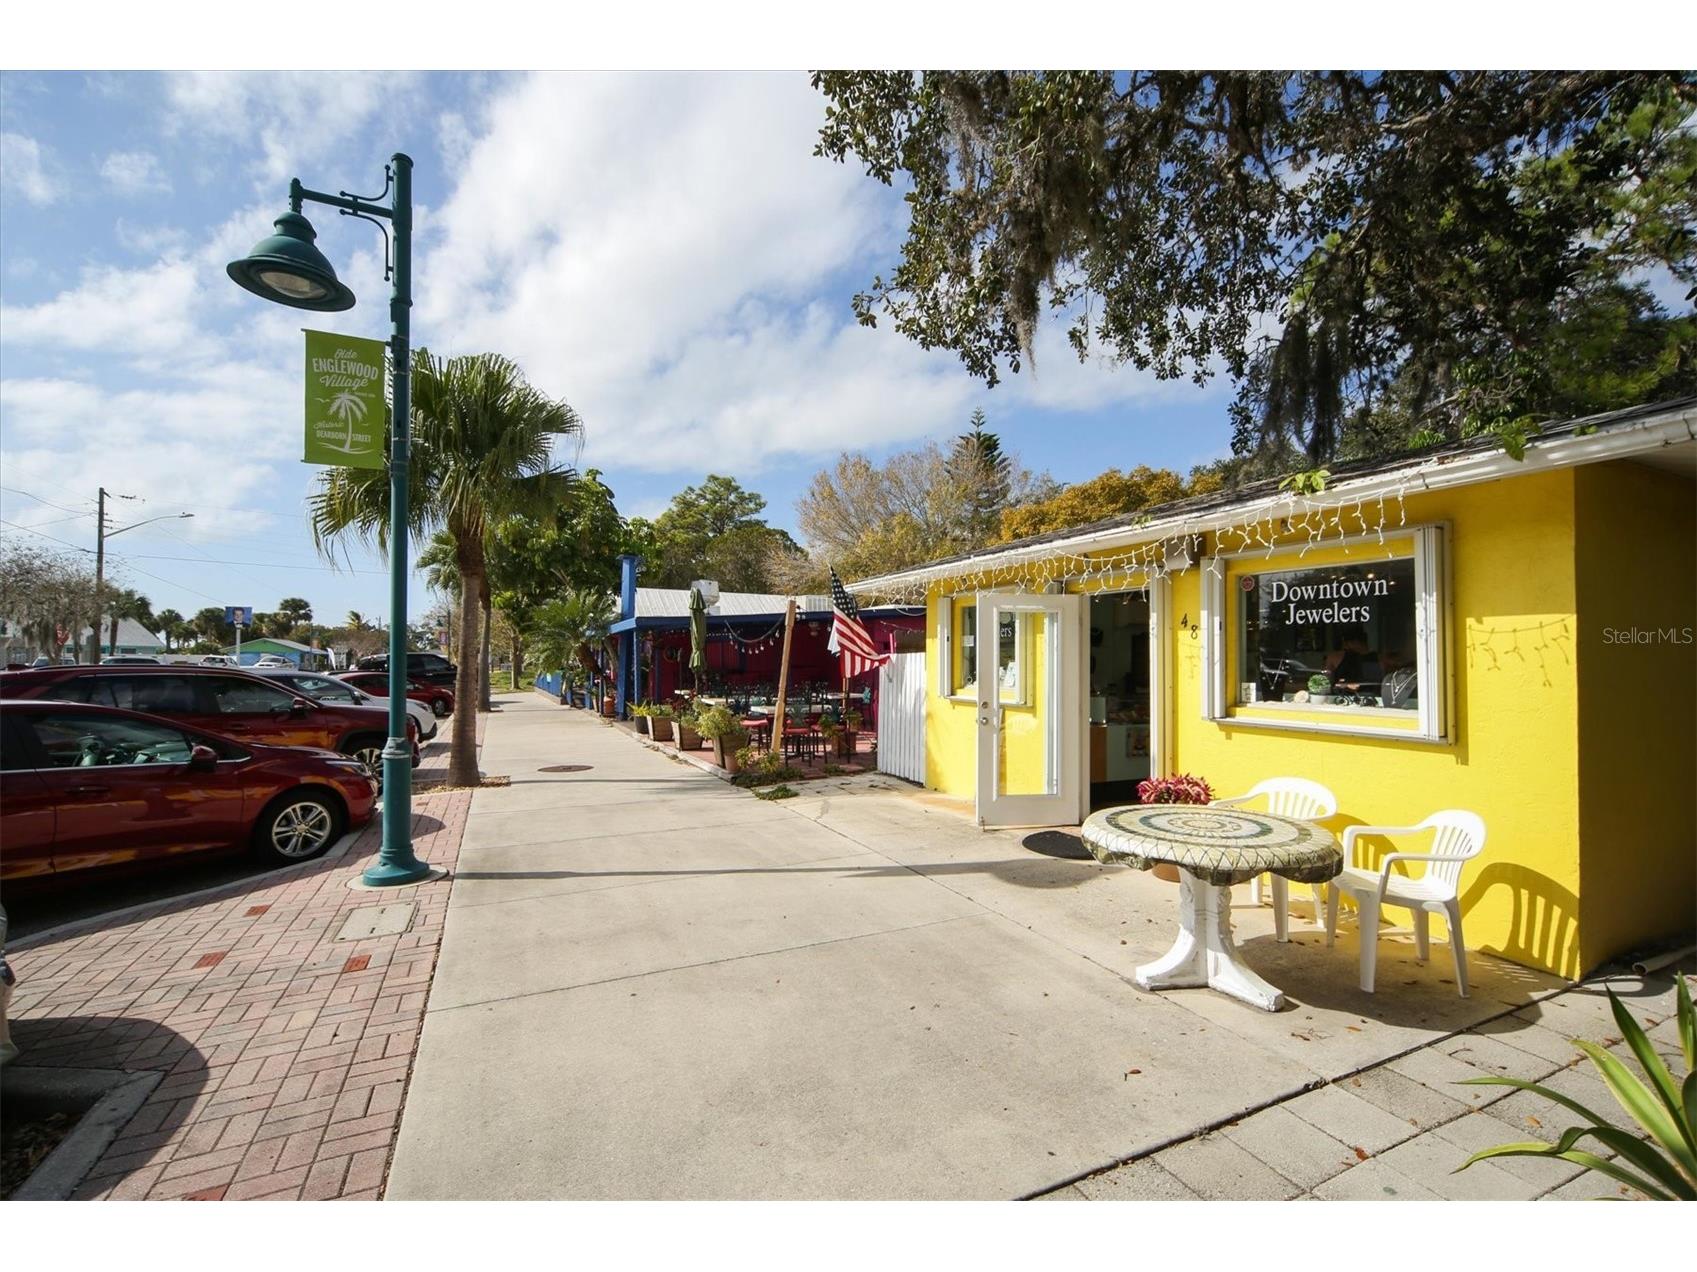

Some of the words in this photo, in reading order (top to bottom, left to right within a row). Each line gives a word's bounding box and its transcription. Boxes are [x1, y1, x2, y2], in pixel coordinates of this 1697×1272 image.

[334, 349, 357, 359] Olde
[312, 358, 378, 380] ENGLEWOOD
[320, 375, 368, 390] Village
[1271, 579, 1389, 603] Downtown
[1285, 601, 1370, 625] Jewelers
[1000, 627, 1012, 638] ers
